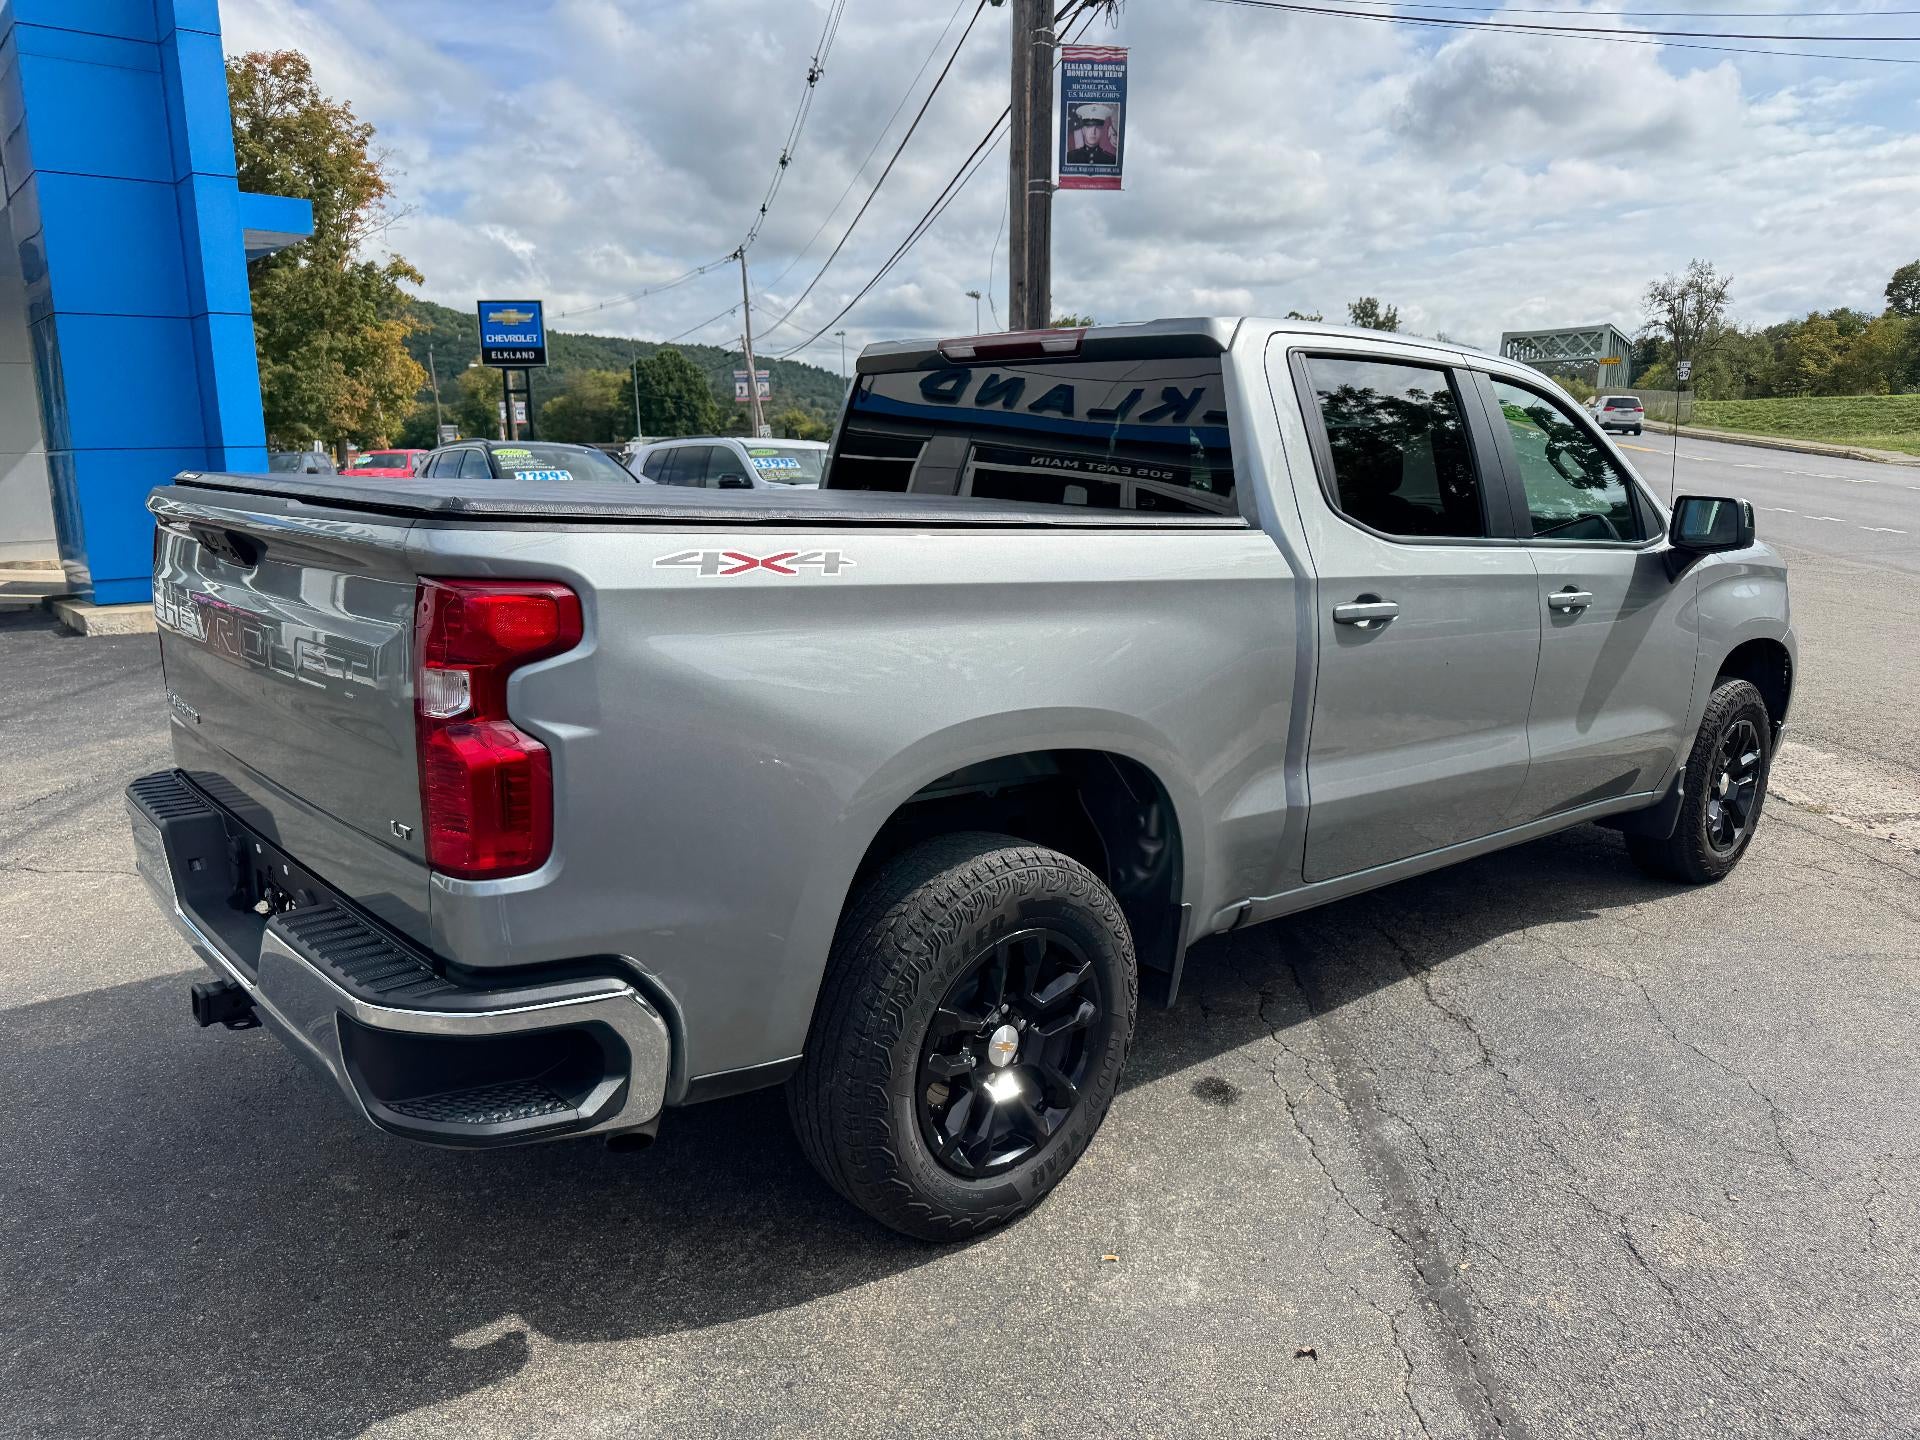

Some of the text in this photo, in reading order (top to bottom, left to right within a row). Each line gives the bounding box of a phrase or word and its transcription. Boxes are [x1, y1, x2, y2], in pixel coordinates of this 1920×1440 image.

[1093, 64, 1126, 72] BOROUGH
[486, 334, 538, 343] CHEVROLET
[491, 350, 535, 360] ELKLAND
[753, 458, 797, 468] 33995
[390, 819, 413, 841] LT
